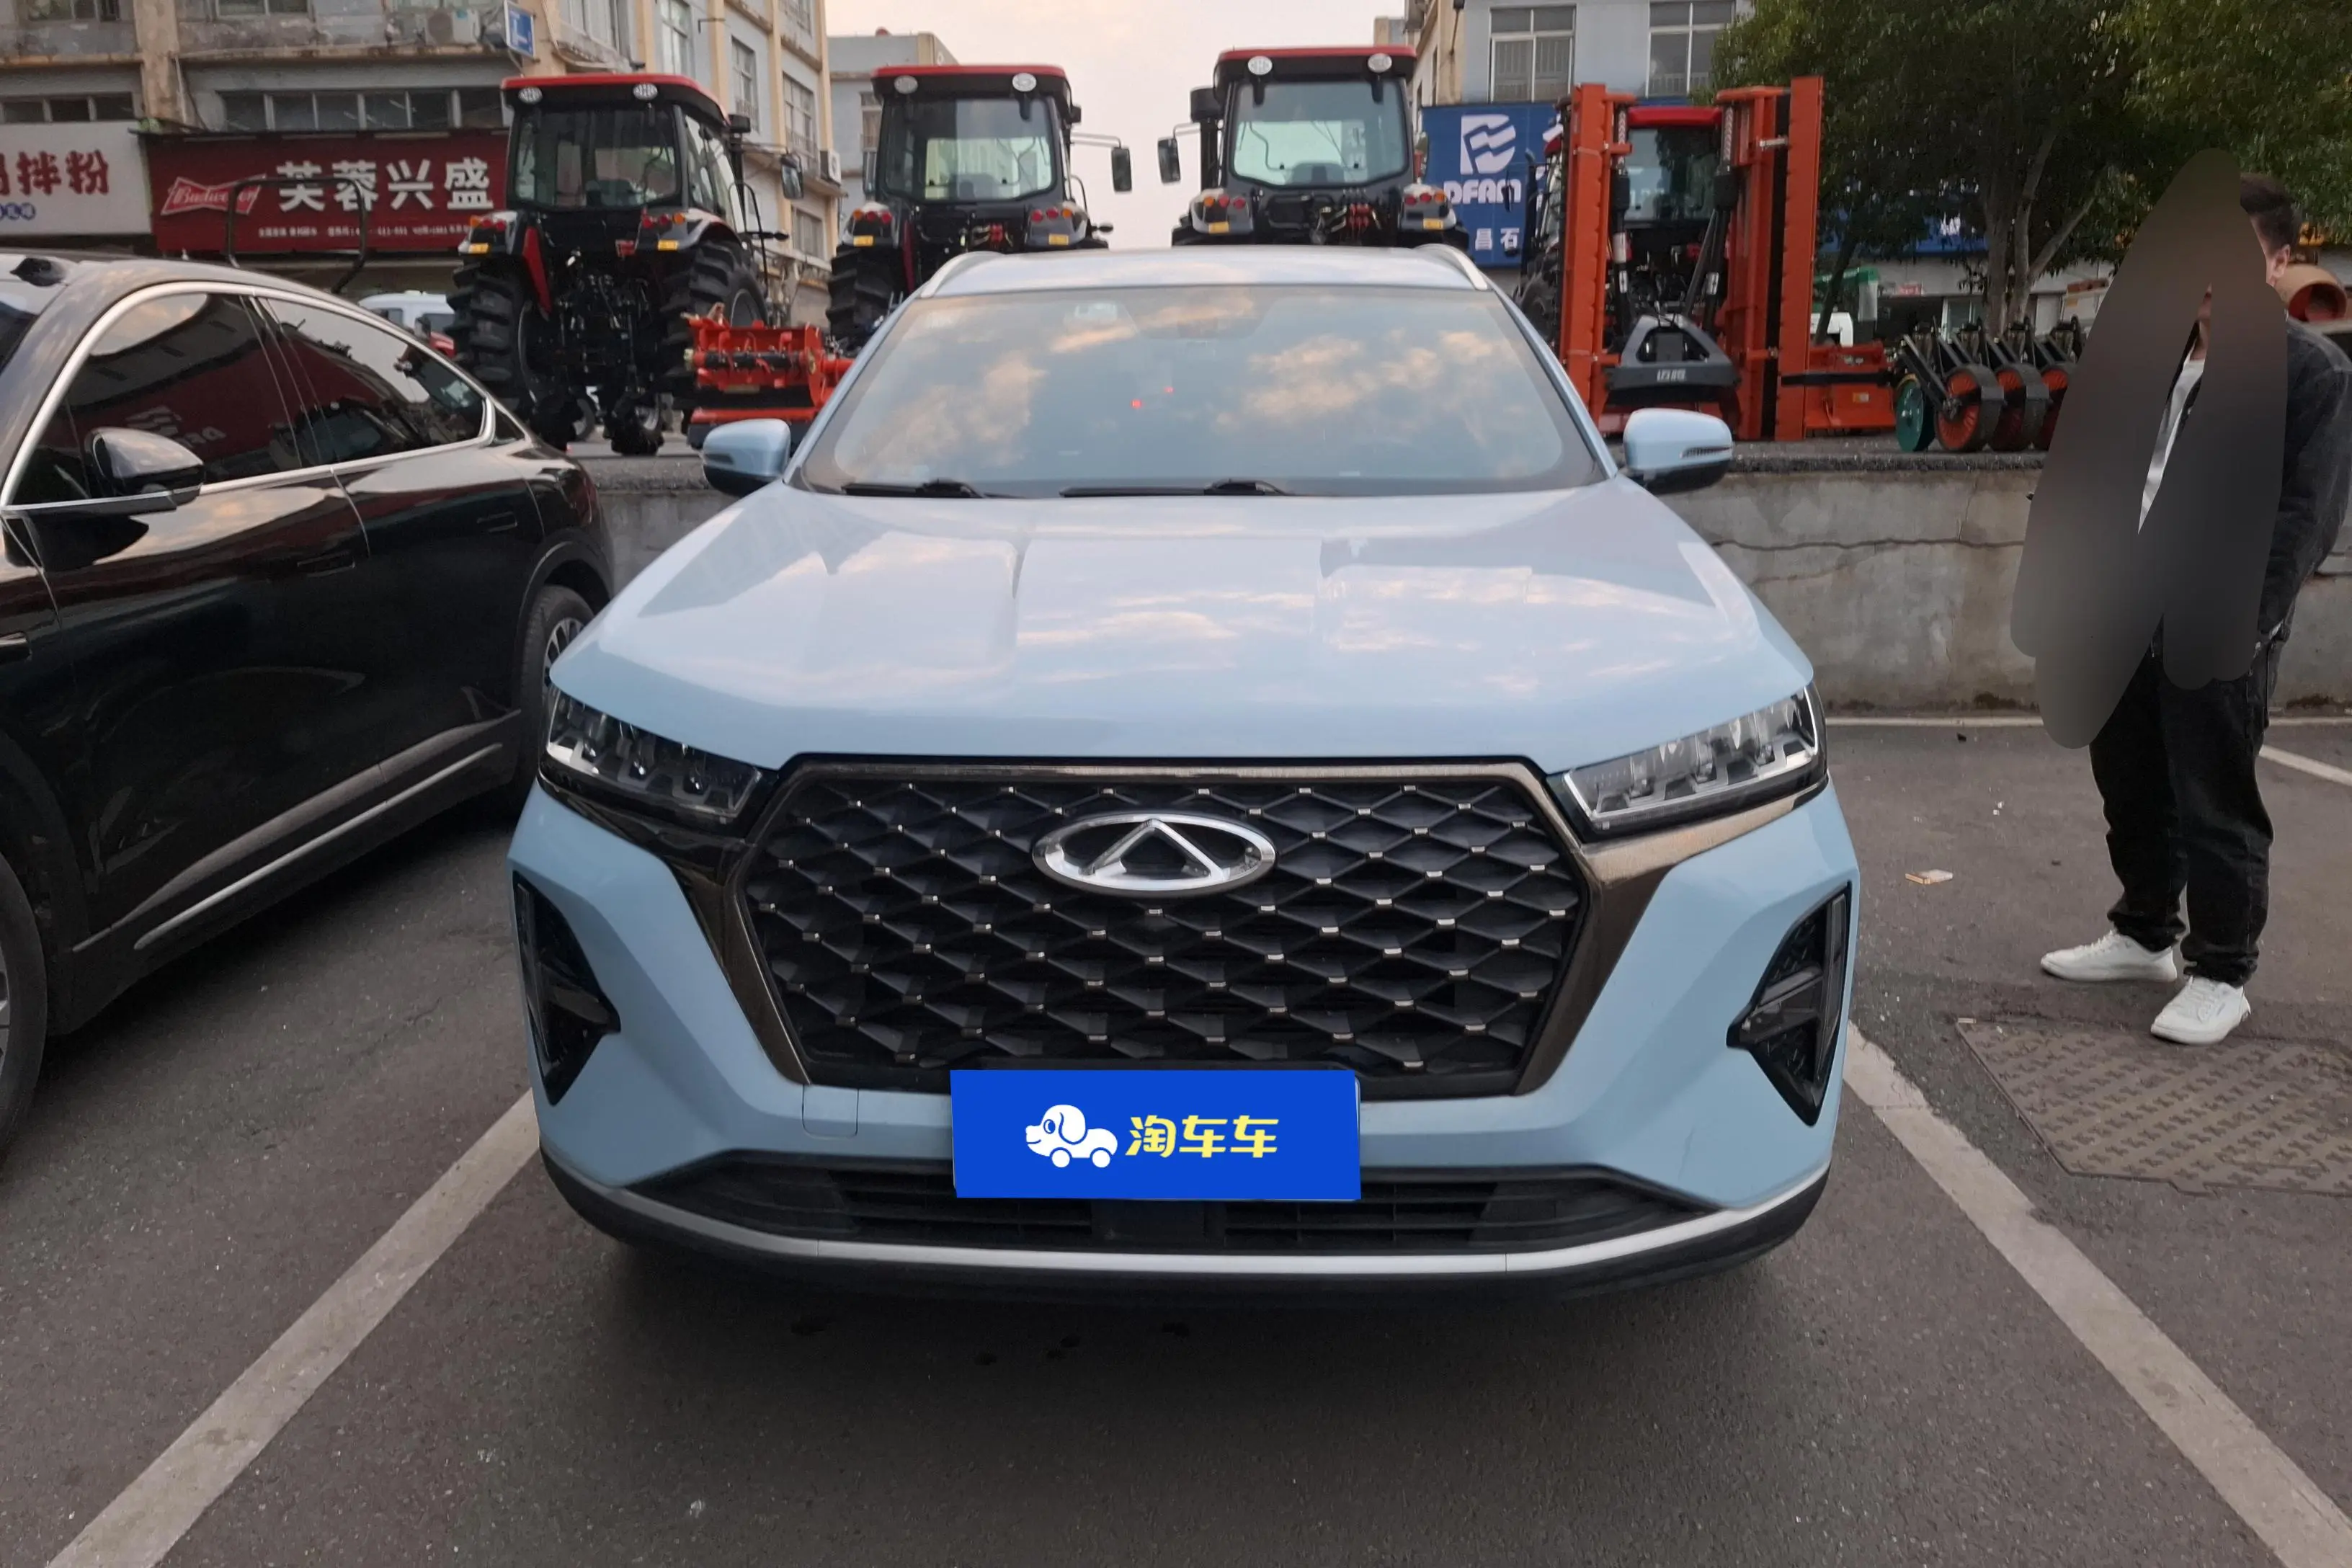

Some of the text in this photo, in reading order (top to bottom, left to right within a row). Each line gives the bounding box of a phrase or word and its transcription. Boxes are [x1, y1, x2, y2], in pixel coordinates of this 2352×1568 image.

[276, 156, 494, 212] 芙蓉兴盛
[1443, 178, 1522, 205] DFAM
